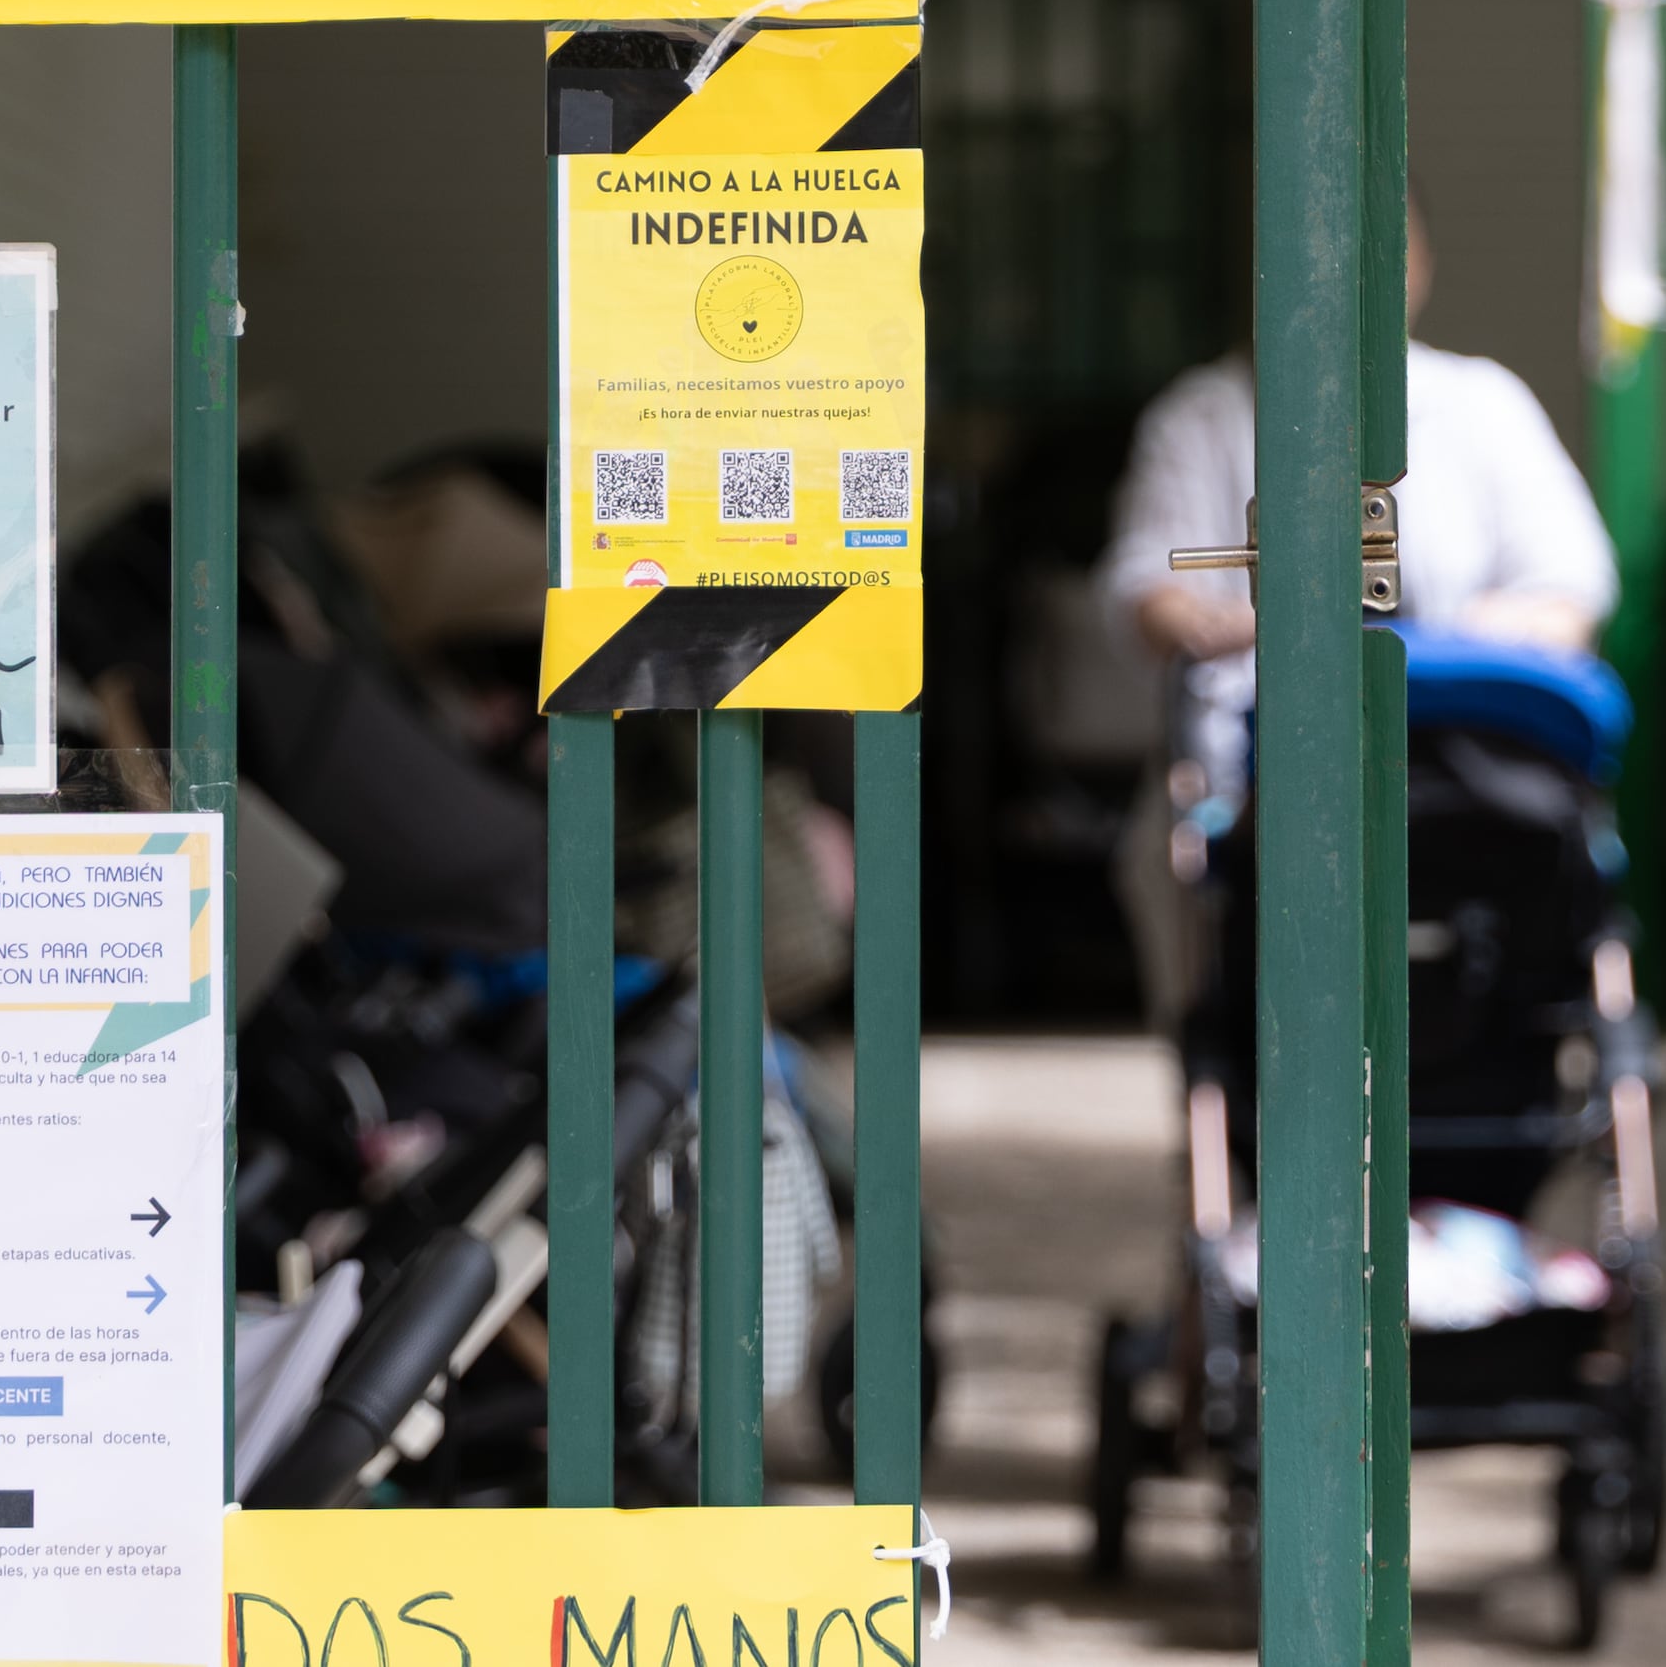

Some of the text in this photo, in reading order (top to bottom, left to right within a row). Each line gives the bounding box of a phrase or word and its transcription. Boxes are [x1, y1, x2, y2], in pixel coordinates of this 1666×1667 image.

[596, 168, 901, 193] CAMINO A LA HUELGA
[631, 210, 869, 246] INDEFINIDA
[704, 263, 796, 308] PLATAFORMA LABORAL
[705, 313, 794, 355] ESCUELAS INFANTILES
[597, 377, 905, 394] Familias, necesitamos vuestro apoyo
[638, 406, 871, 422] ¡Es hora de enviar nuestras quejas!
[861, 534, 902, 545] MADRID
[695, 570, 891, 587] #PLEISOMOSTOD@S
[21, 866, 72, 884] PERO
[84, 862, 163, 883] TAMBIÉN
[93, 890, 164, 908] DIGNAS
[41, 942, 88, 959] PARA
[100, 941, 163, 959] PODER
[39, 967, 59, 985] LA
[65, 967, 148, 985] INFANCIA:
